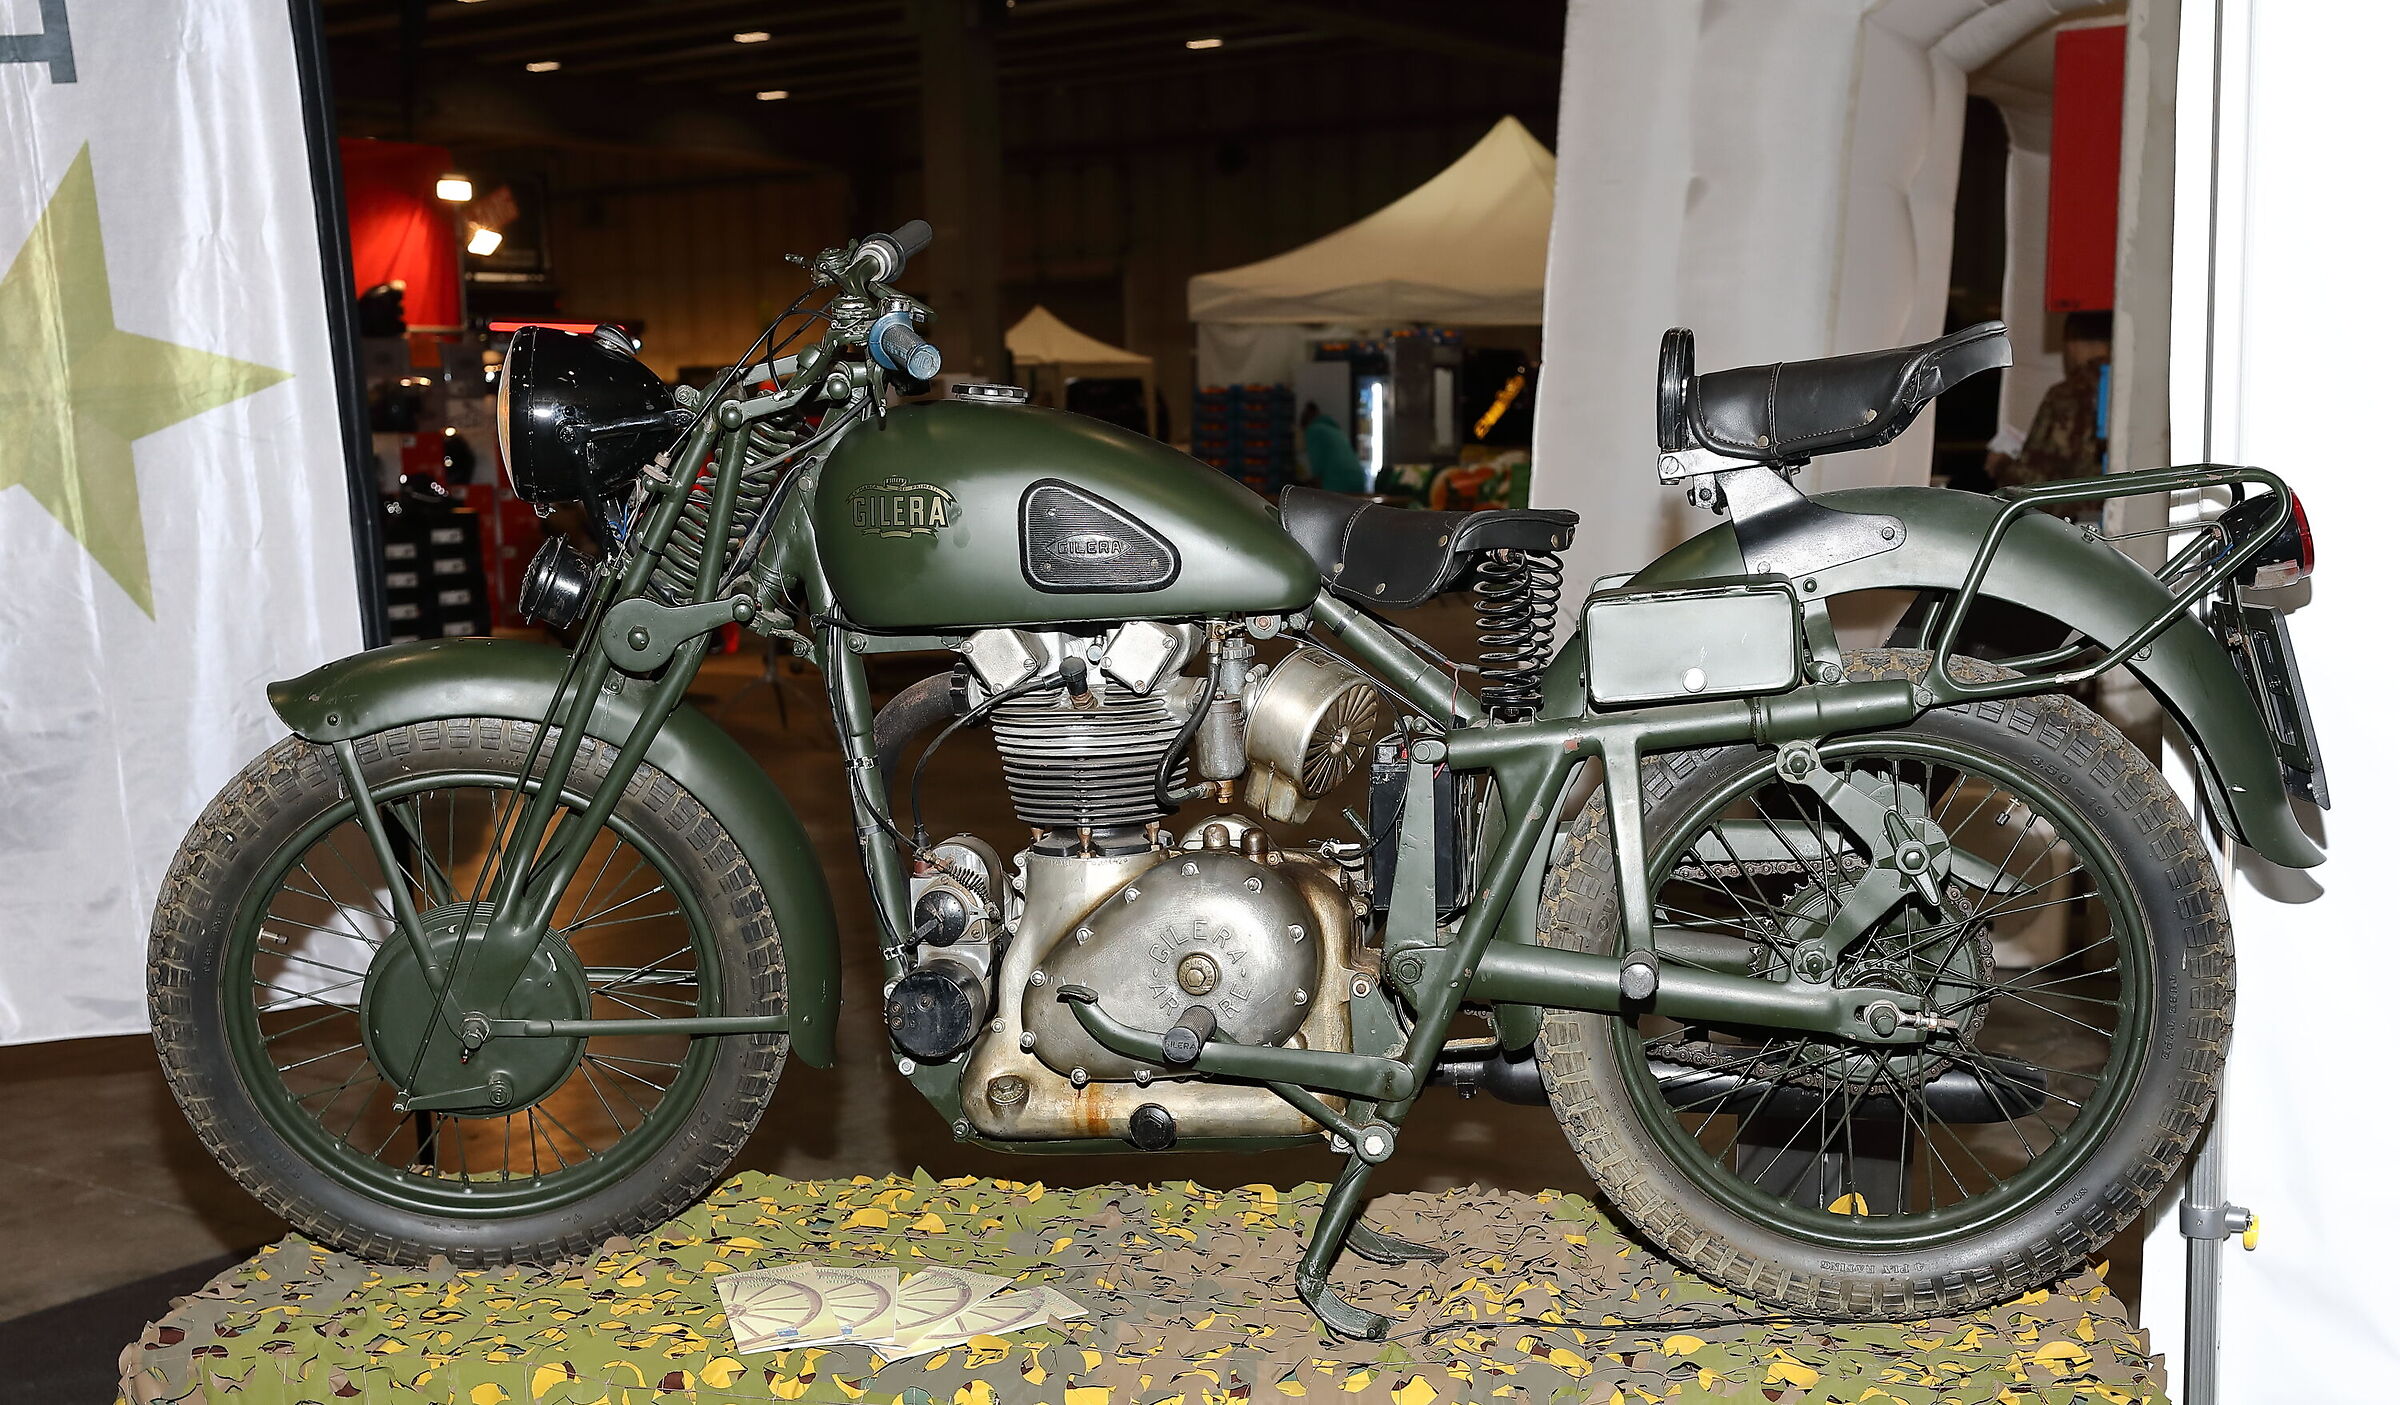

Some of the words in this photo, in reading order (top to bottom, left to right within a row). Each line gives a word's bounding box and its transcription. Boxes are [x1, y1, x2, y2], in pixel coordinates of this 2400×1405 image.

[852, 495, 949, 527] GILERA
[1057, 540, 1121, 554] GILERA
[1149, 919, 1247, 964] GILERA
[1149, 982, 1251, 1020] ARRE
[1164, 1039, 1197, 1051] GILERA
